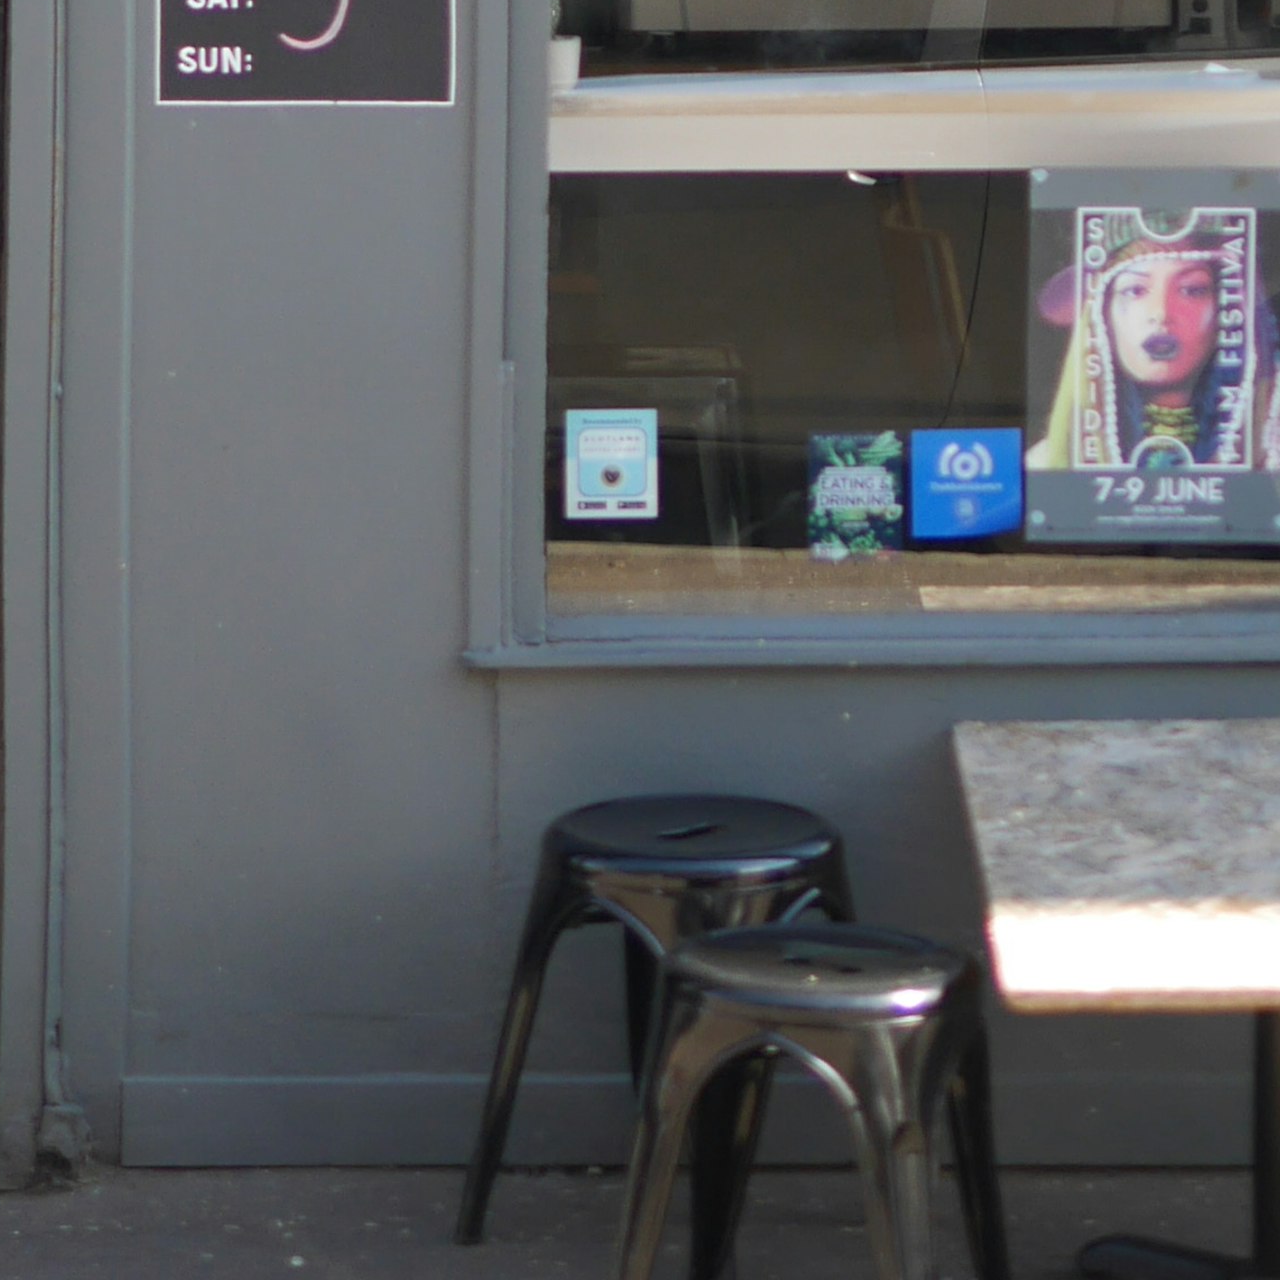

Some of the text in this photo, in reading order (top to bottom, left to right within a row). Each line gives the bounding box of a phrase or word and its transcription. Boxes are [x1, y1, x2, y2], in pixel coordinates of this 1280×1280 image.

[177, 46, 253, 75] SUN:
[1218, 217, 1246, 367] FESTIVAL
[821, 477, 876, 490] EATING
[1095, 476, 1225, 503] 7-9 JUNE
[820, 493, 894, 506] DRINKING
